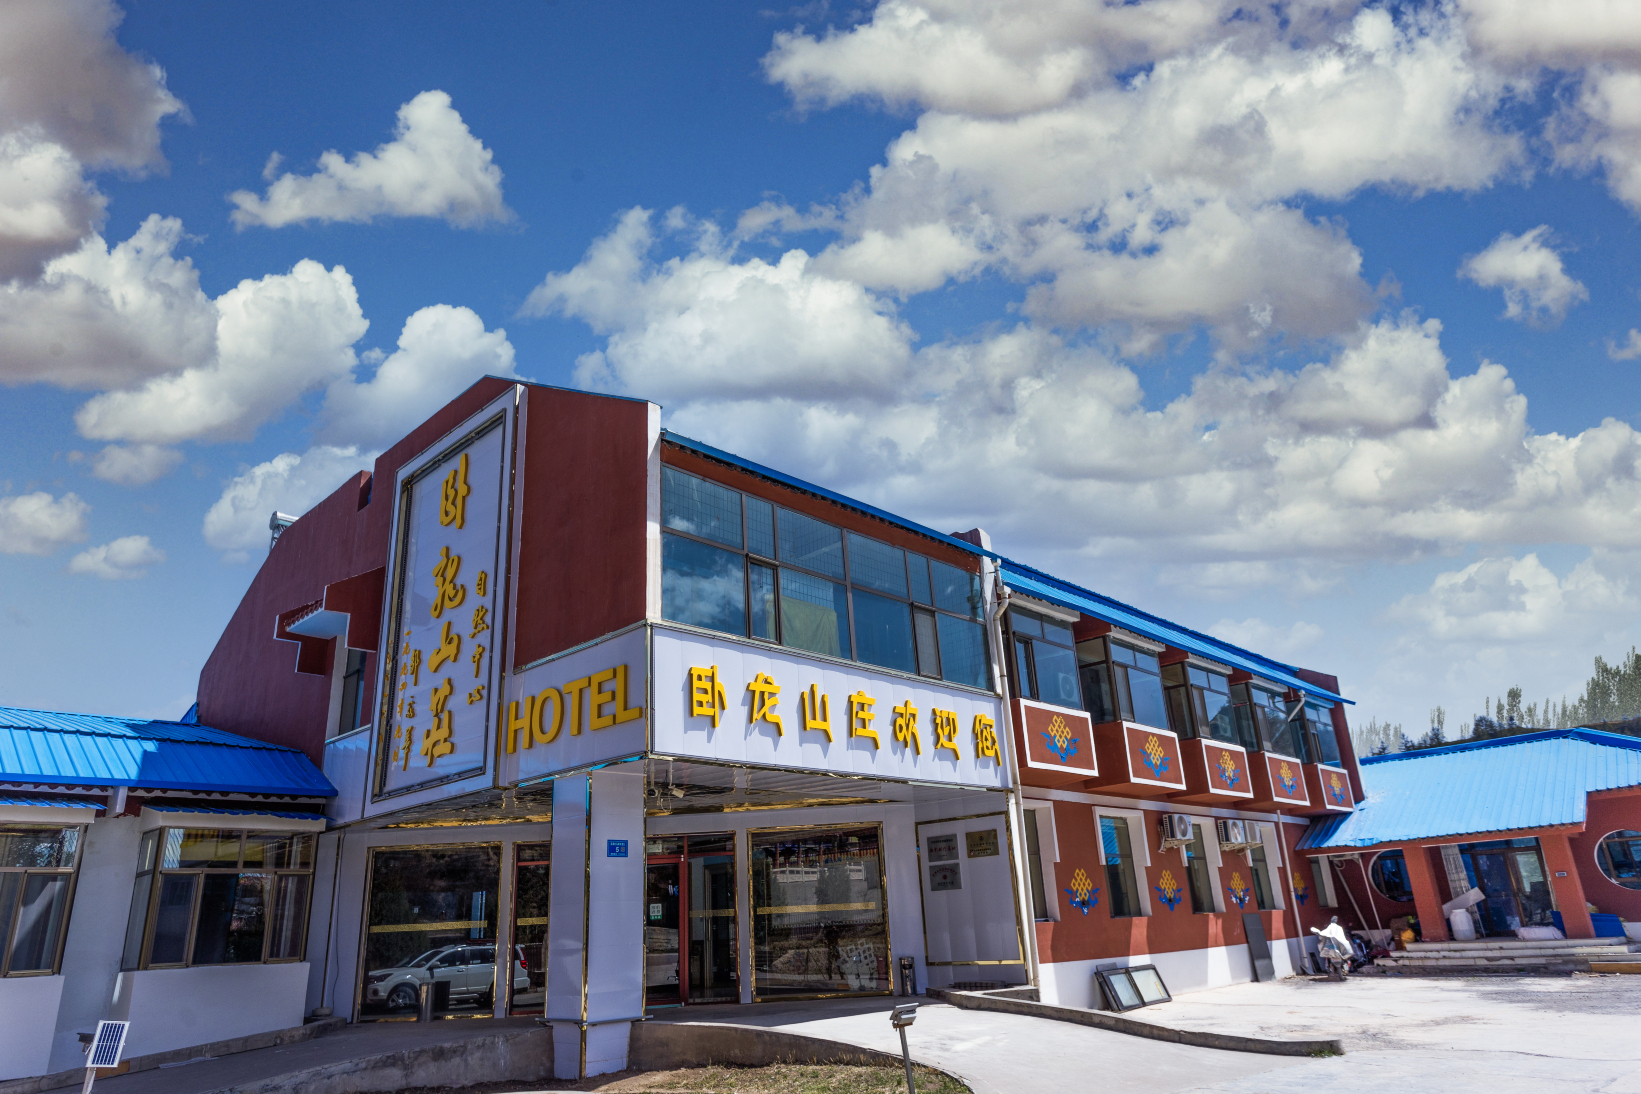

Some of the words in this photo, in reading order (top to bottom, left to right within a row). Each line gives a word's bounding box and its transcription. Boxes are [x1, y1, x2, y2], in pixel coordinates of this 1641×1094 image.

[506, 664, 643, 755] HOTEL
[688, 664, 1003, 767] 卧龙山庄欢迎您
